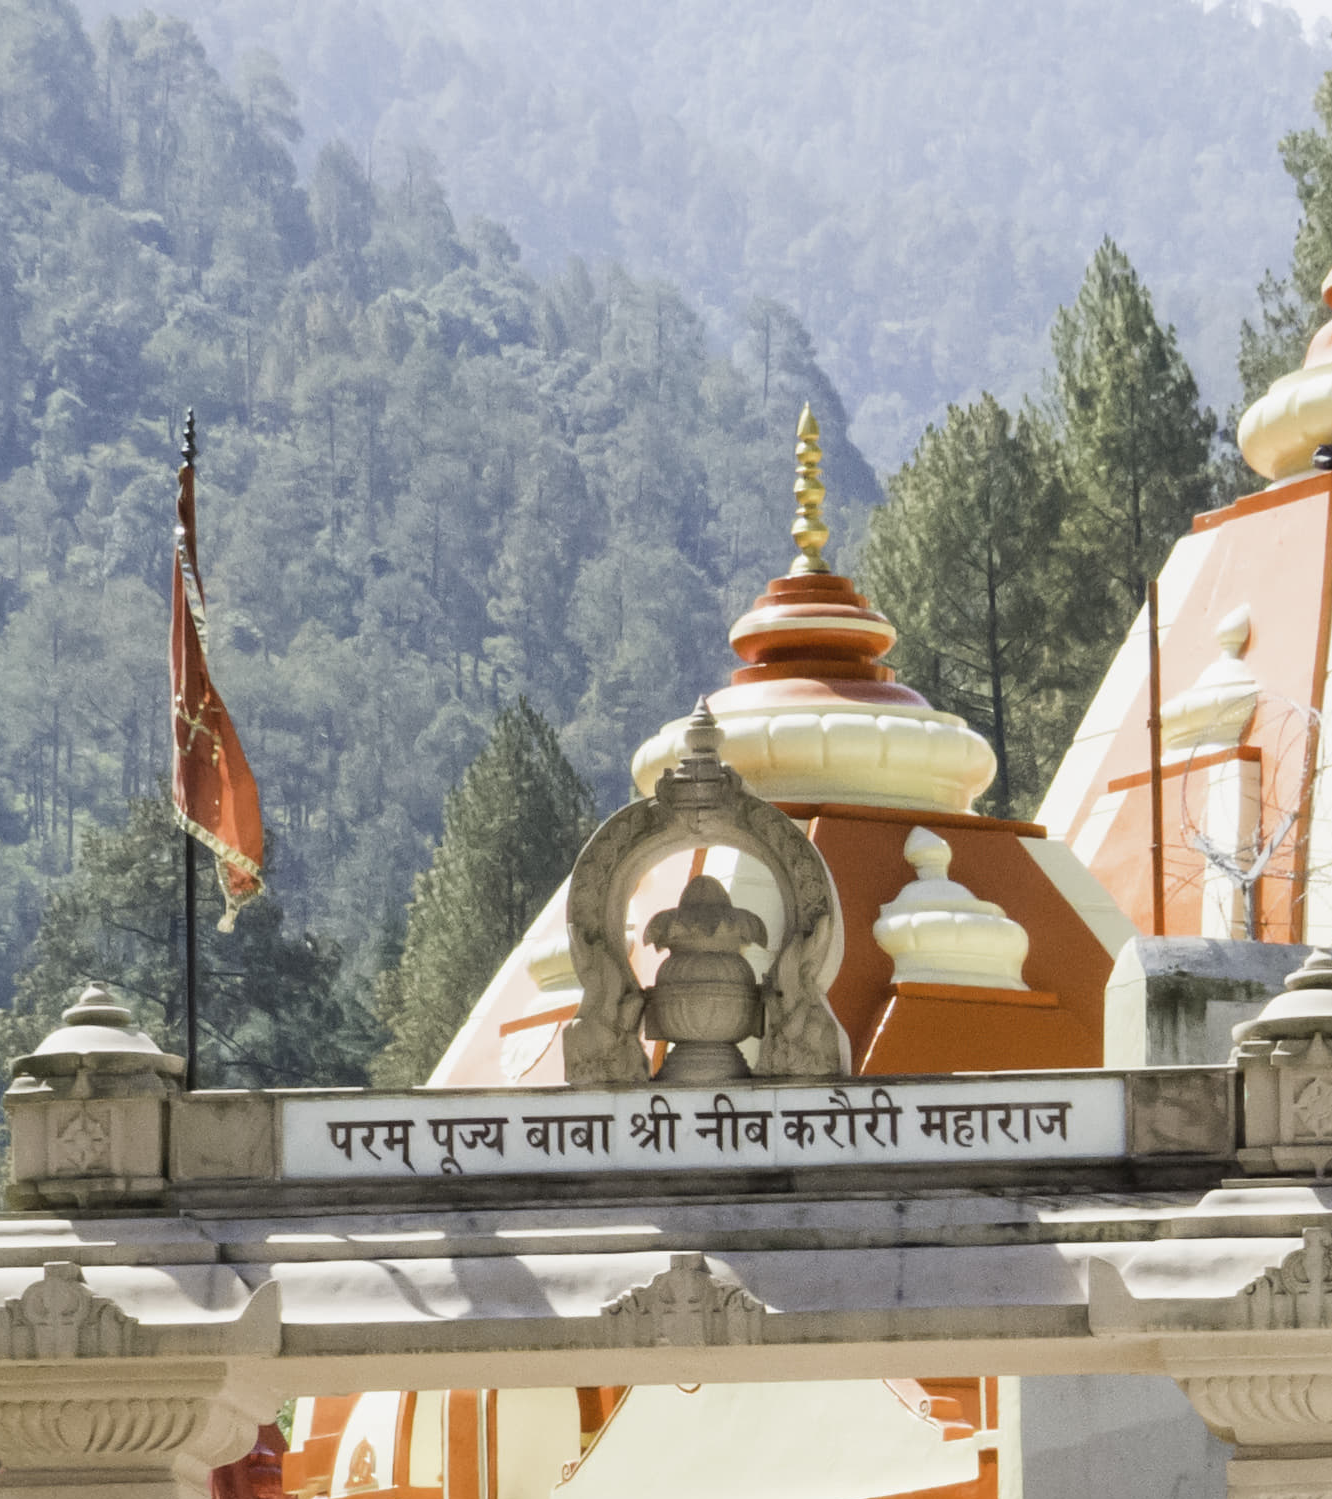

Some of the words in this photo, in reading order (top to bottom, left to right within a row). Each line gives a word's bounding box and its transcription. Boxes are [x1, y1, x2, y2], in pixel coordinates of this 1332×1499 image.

[327, 1119, 416, 1173] परम्
[428, 1117, 509, 1173] पूज्य
[522, 1115, 614, 1155] बाबा
[630, 1095, 681, 1153] श्री
[695, 1093, 773, 1152] नीब
[782, 1089, 903, 1148] करौरी
[917, 1102, 1072, 1148] महाराज
